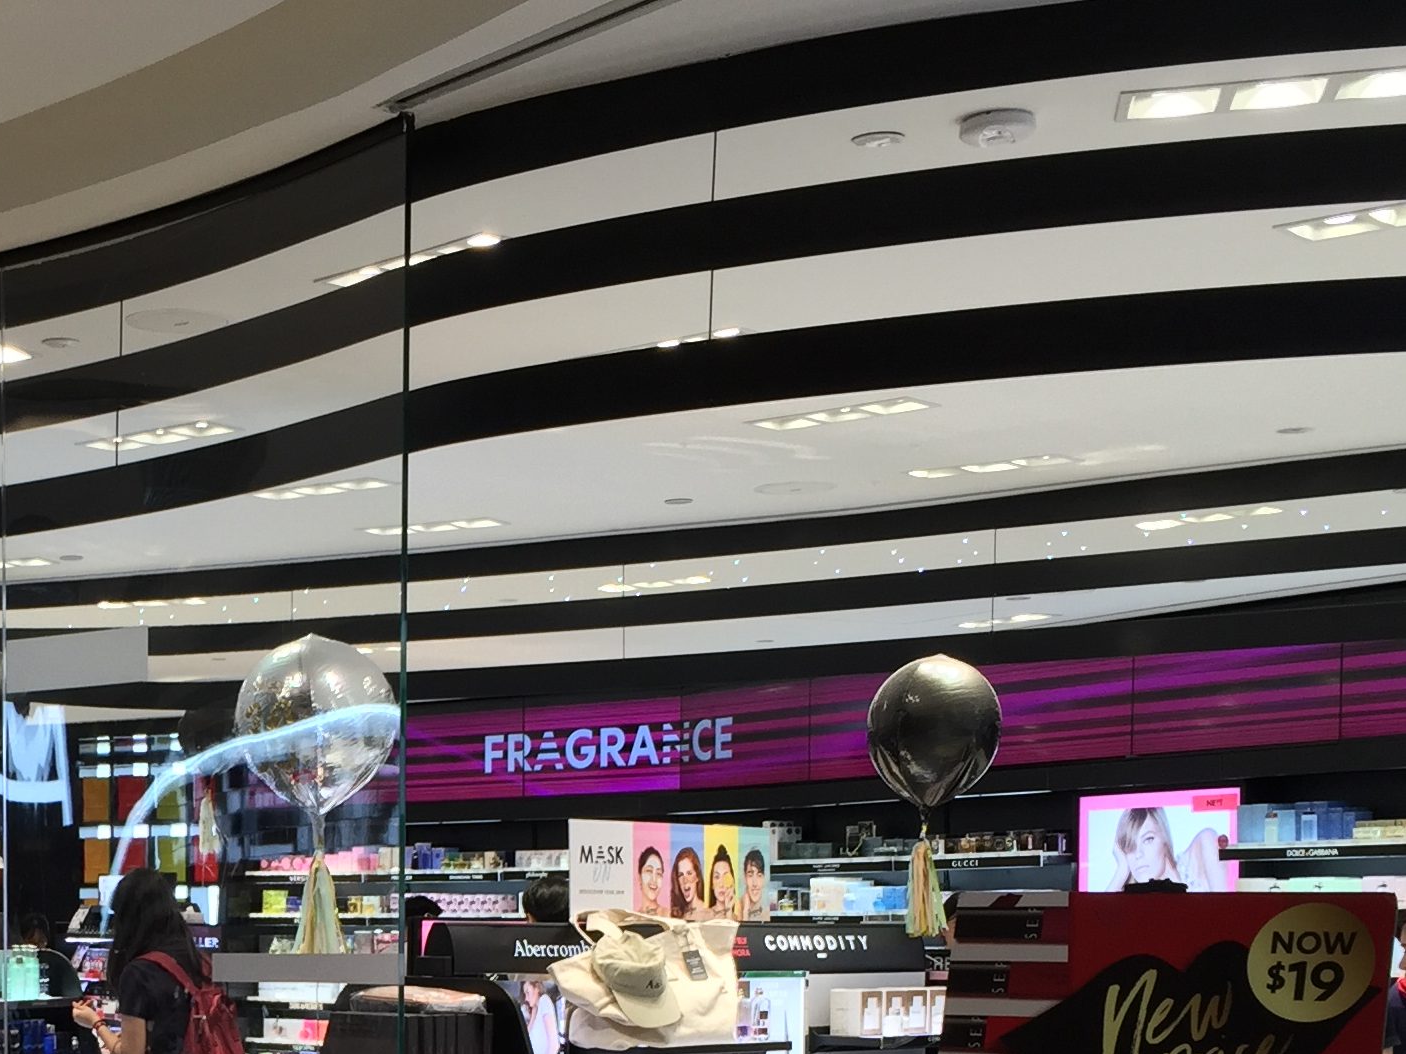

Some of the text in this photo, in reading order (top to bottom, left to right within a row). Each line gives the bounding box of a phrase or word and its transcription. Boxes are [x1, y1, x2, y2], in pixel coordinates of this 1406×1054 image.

[484, 716, 734, 774] FRAGRANCE
[579, 845, 624, 864] MASK
[951, 859, 979, 867] GUCCI
[764, 934, 869, 952] COMMODITY
[1270, 930, 1358, 956] NOW
[1265, 960, 1346, 1002] $19
